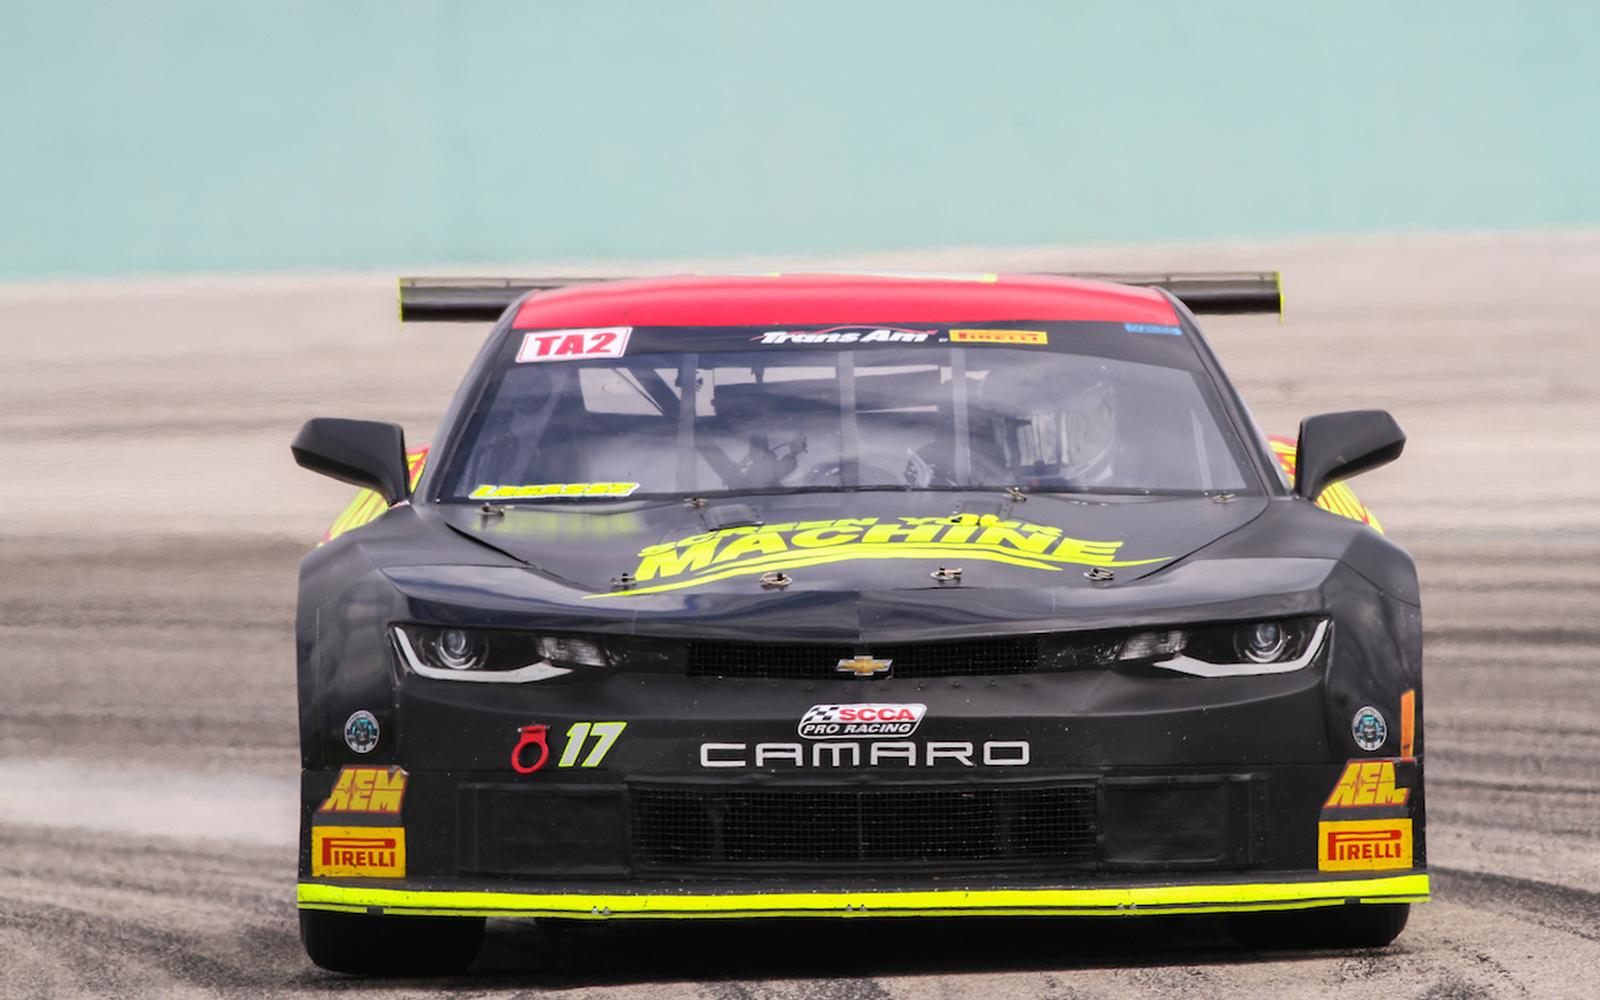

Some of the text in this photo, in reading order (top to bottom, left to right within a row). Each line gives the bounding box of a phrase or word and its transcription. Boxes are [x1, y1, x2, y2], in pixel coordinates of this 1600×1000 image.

[534, 332, 618, 357] TA2
[760, 329, 929, 344] Trans Am
[634, 524, 1124, 581] MACHINE
[803, 723, 912, 734] PRO RACING
[839, 708, 916, 721] SCCA
[557, 721, 628, 768] 17
[700, 741, 1030, 767] CAMARO
[321, 768, 408, 813] AEM
[1325, 760, 1411, 807] AEM
[322, 837, 397, 867] PIRELLI
[1327, 829, 1402, 861] PIRELLI
